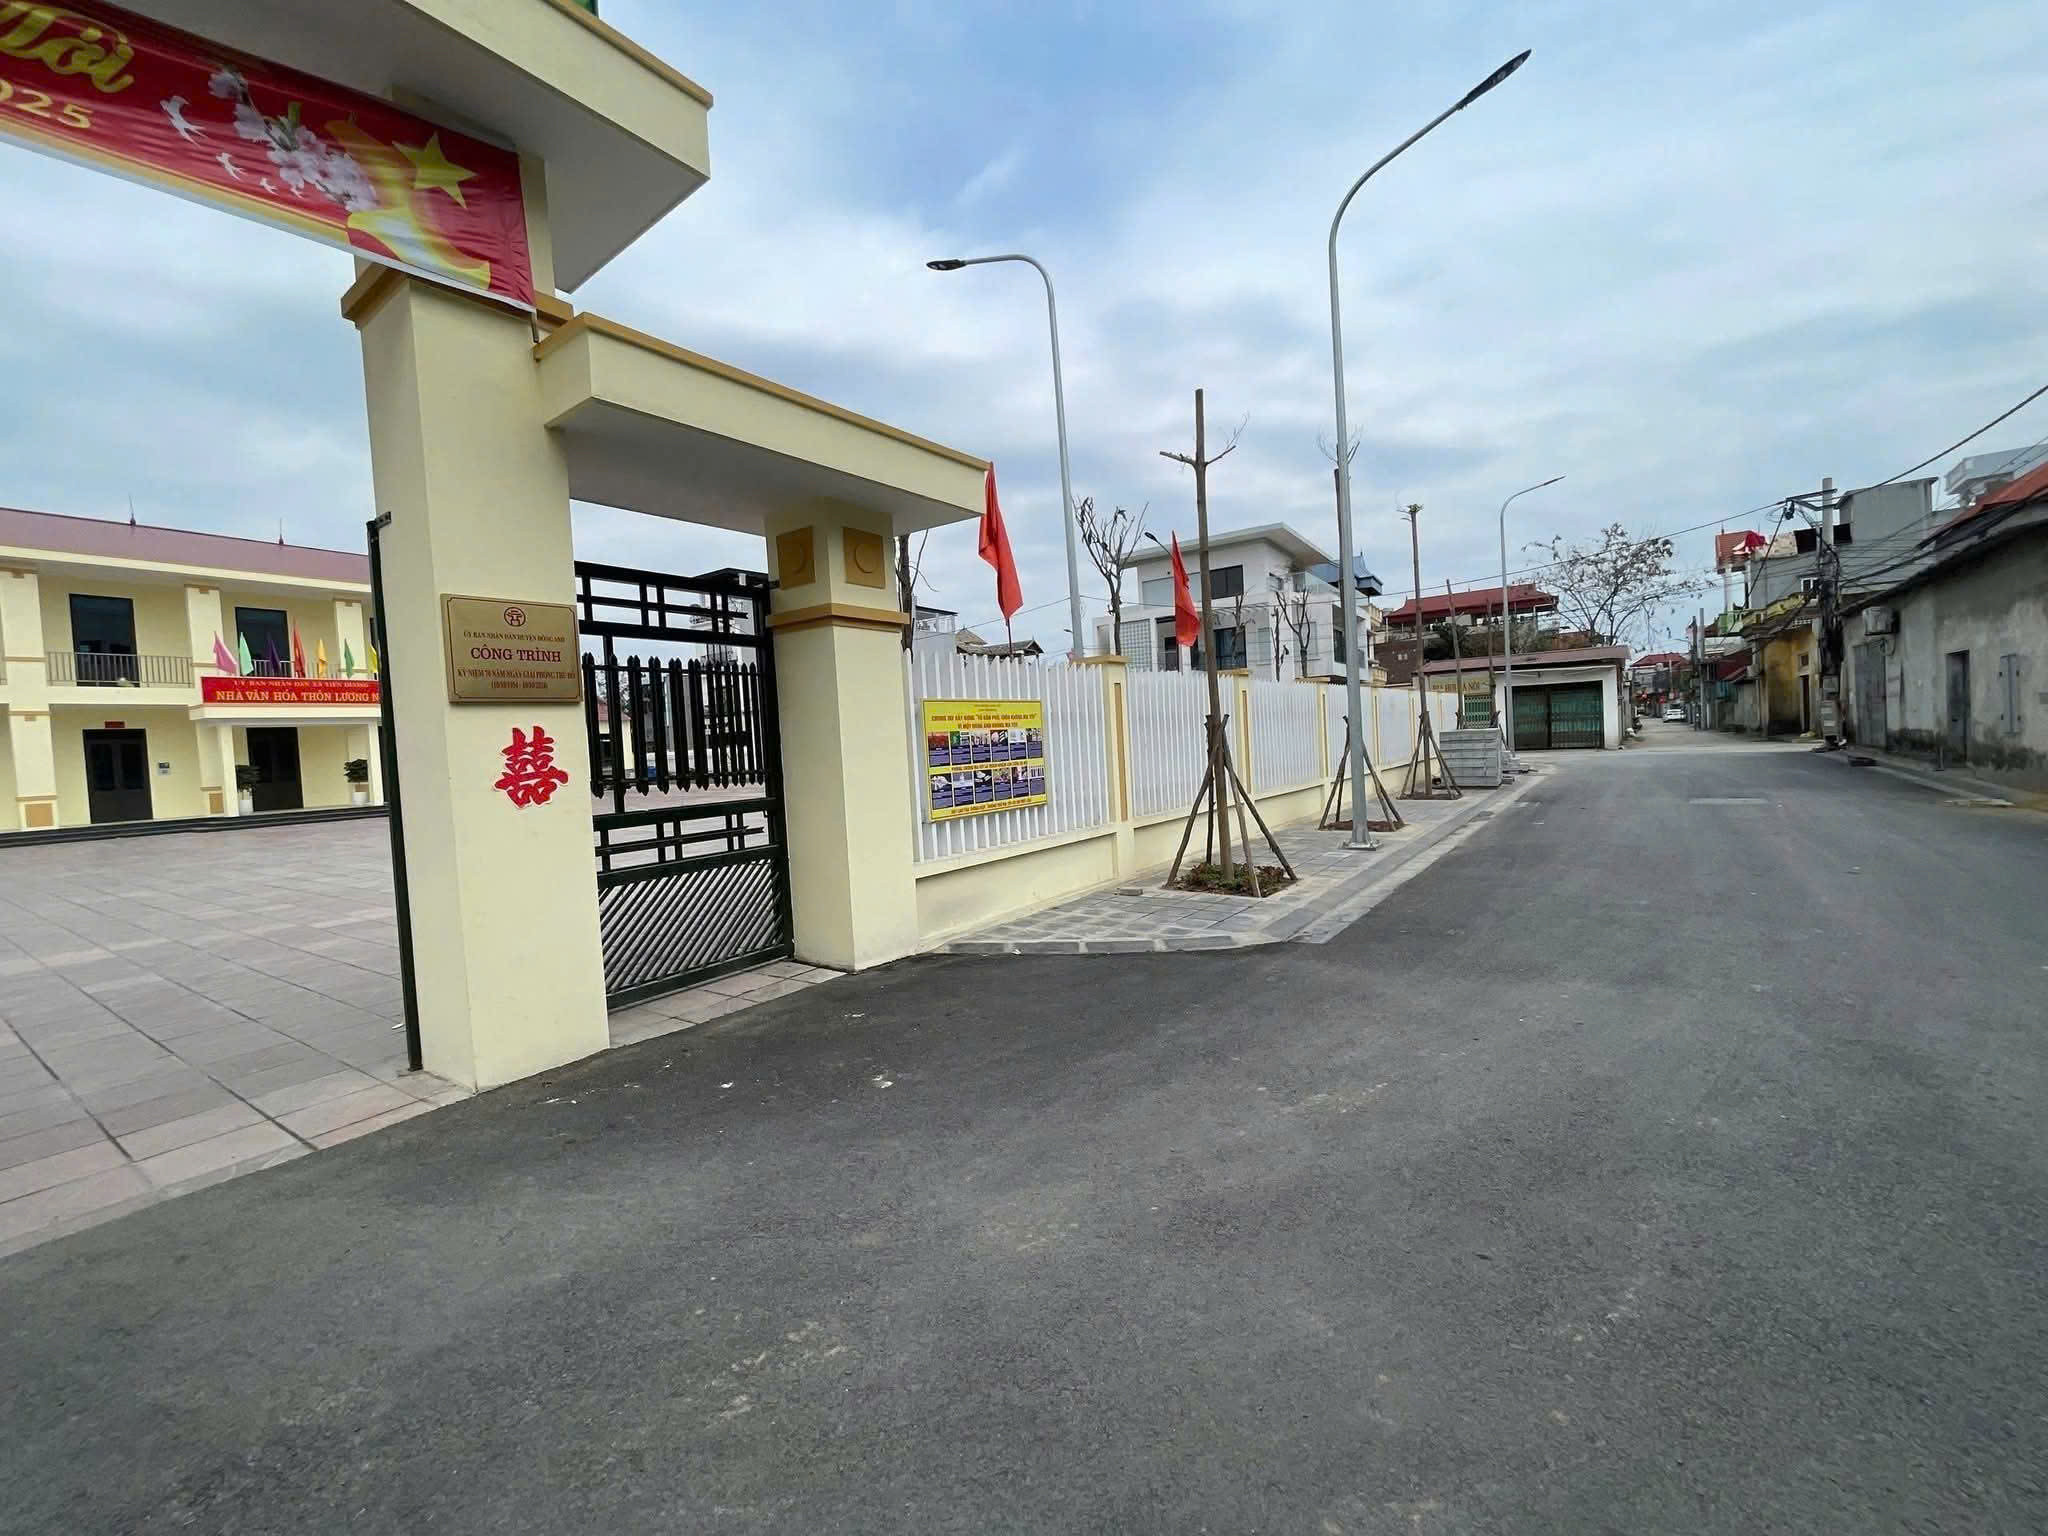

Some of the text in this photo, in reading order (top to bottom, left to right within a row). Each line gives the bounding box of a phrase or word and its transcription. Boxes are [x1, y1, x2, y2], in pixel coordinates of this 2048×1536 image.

[471, 643, 561, 662] CÔNG TRÌNH
[216, 688, 244, 701] NHÀ
[245, 689, 269, 701] VĂN
[273, 688, 298, 701] HÓA
[301, 689, 332, 702] THÔN
[335, 690, 369, 702] LƯƠNG
